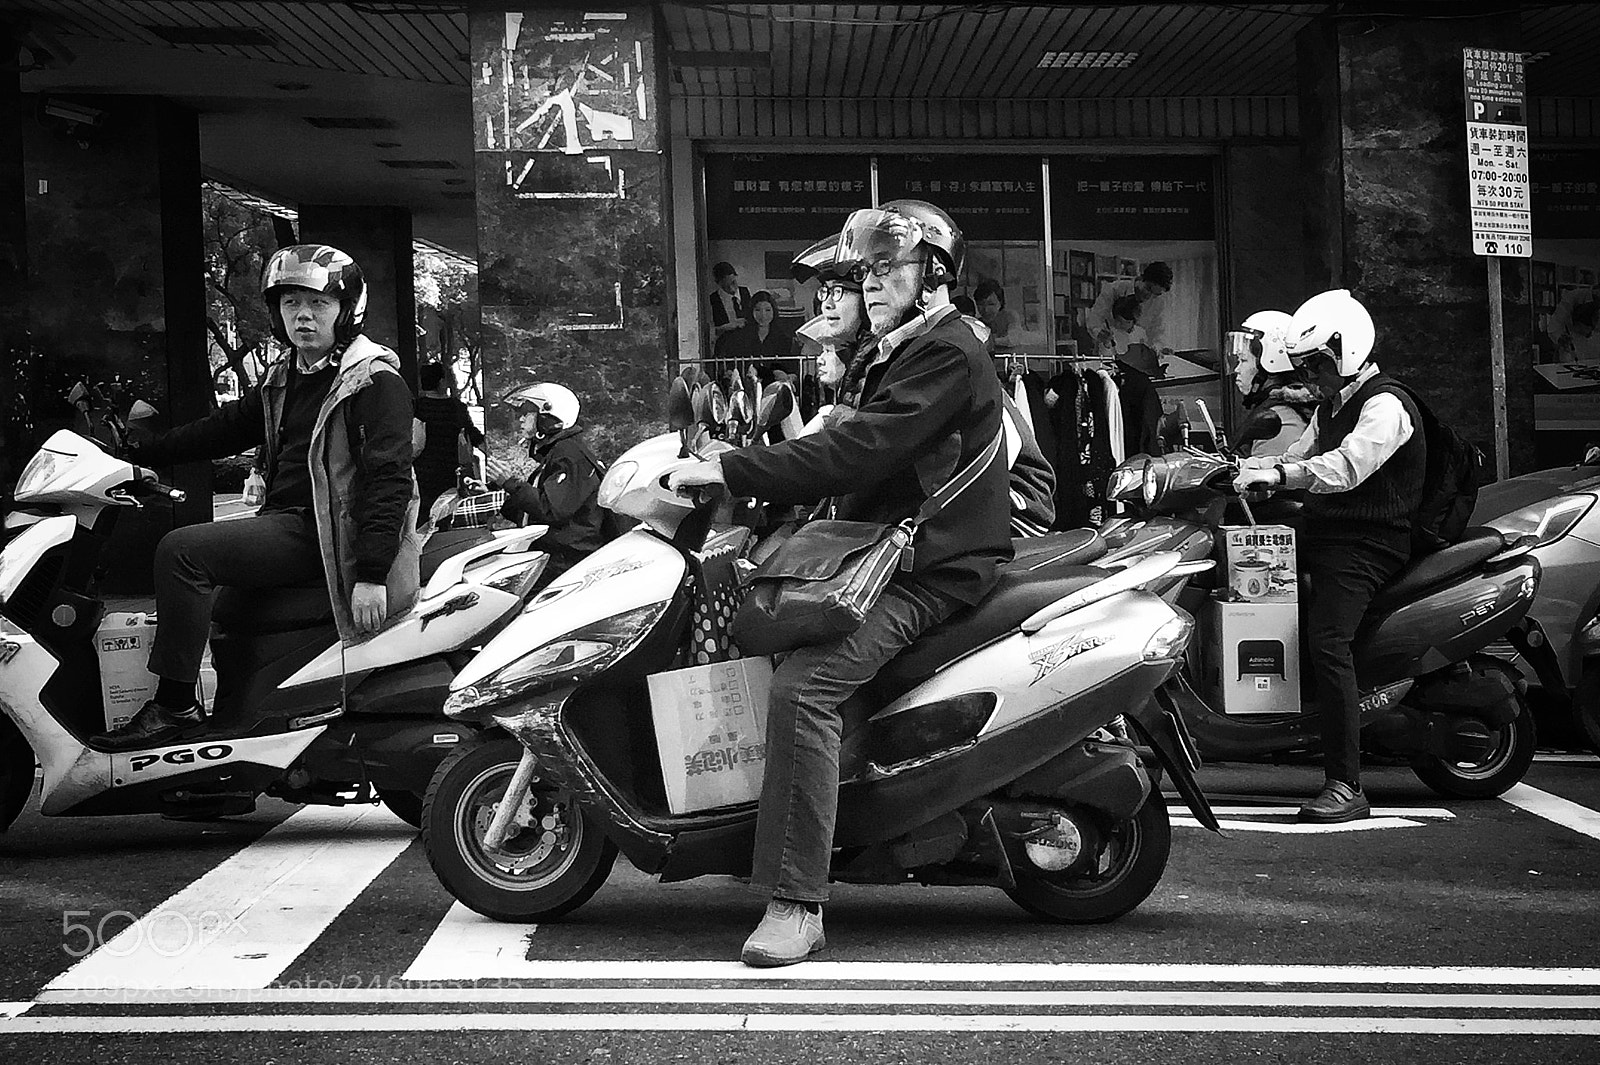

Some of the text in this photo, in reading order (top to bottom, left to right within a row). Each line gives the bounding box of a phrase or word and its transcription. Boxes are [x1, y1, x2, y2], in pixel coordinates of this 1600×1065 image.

[1474, 102, 1485, 120] P
[1470, 143, 1527, 158] 週一至週六
[1471, 170, 1528, 184] 07:00-20:00
[1477, 184, 1524, 199] 每次30元
[1505, 243, 1523, 255] 110
[130, 744, 233, 772] PGO
